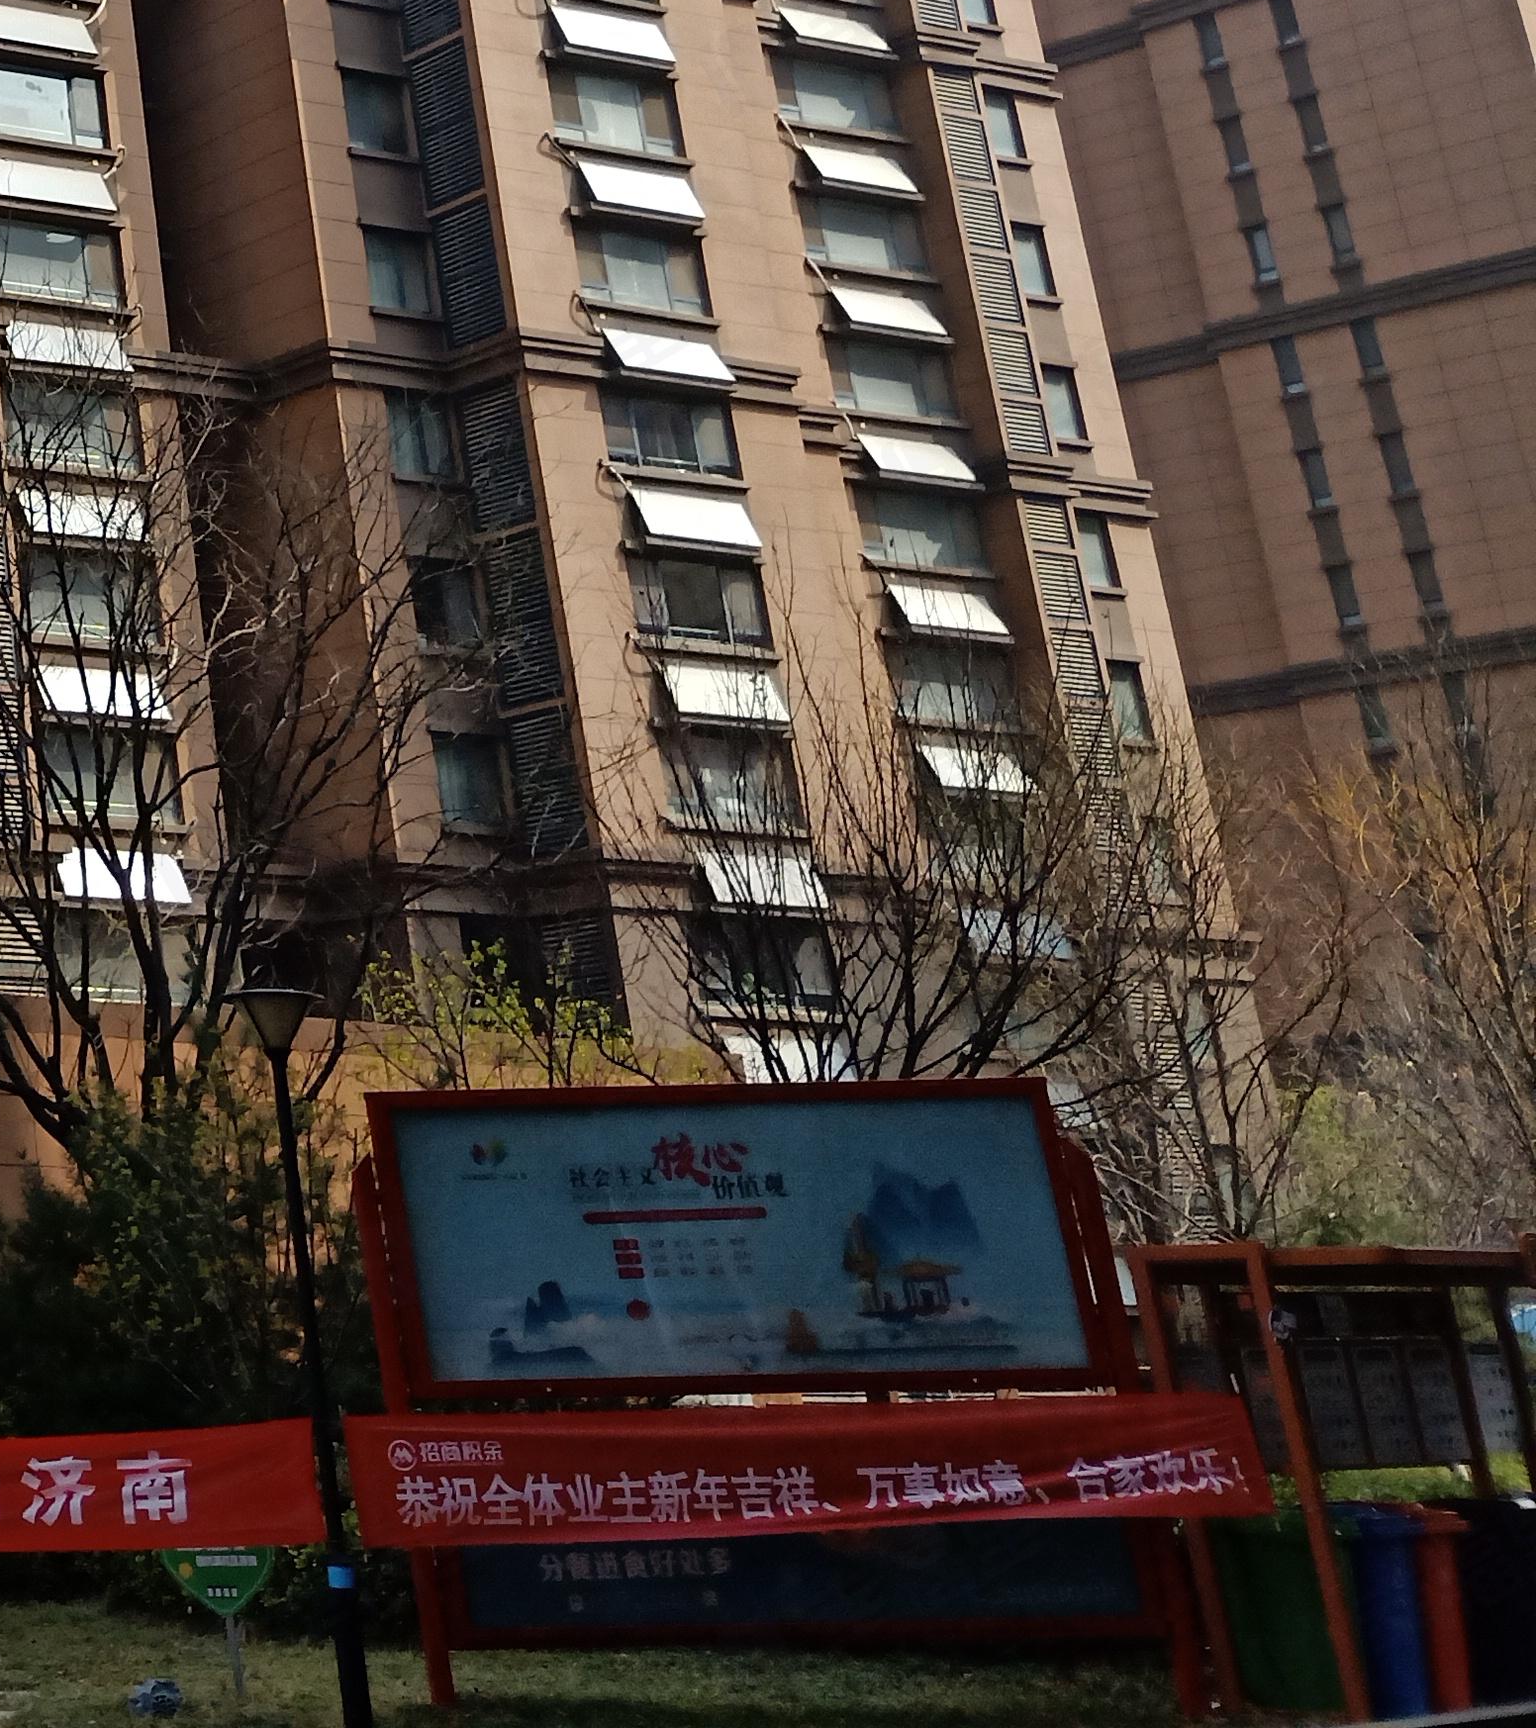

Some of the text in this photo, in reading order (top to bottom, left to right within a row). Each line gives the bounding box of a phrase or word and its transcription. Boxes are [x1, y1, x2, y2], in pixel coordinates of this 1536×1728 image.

[651, 1132, 749, 1187] 核心
[569, 1166, 657, 1188] 社会主义
[712, 1174, 787, 1199] 价值观
[419, 1440, 504, 1463] 招商积余
